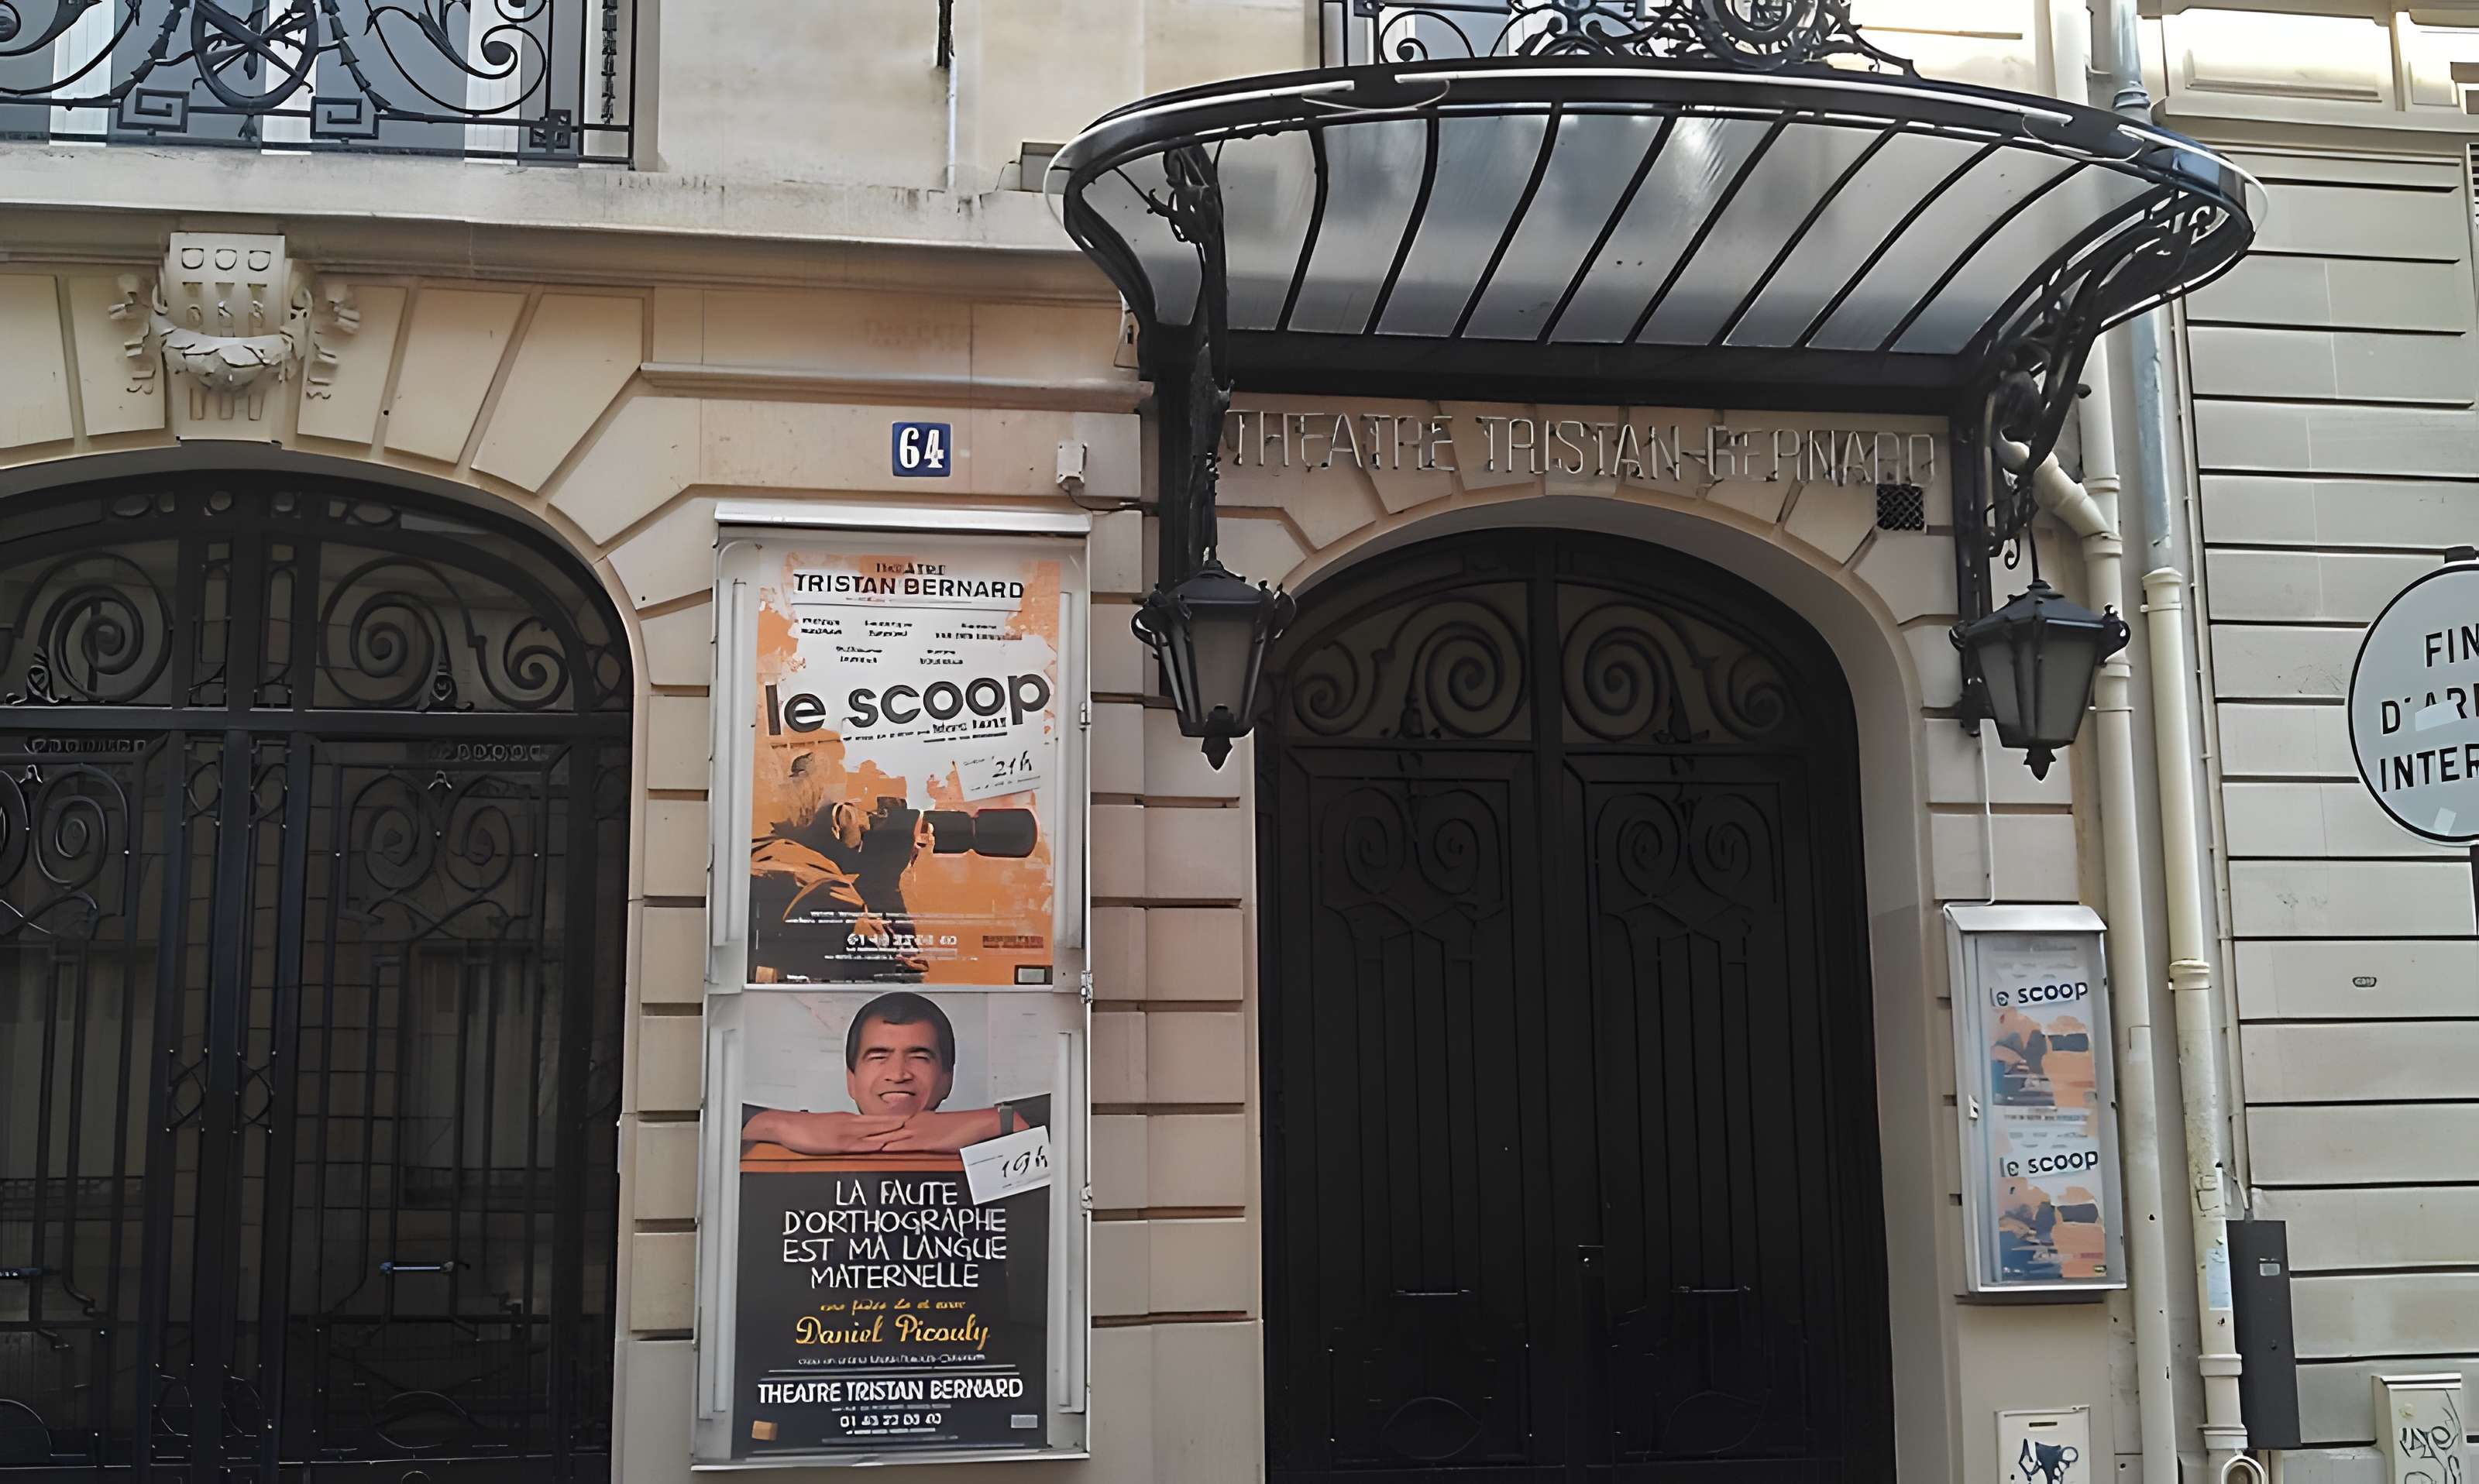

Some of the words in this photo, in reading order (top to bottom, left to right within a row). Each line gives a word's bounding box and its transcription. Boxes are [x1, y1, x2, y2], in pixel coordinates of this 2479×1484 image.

[899, 427, 944, 469] 64
[794, 573, 896, 595] TRISTAN
[903, 578, 1024, 599] BERNARD
[2426, 623, 2479, 668] FIN
[765, 684, 827, 736] le
[848, 673, 1050, 728] scoop
[2379, 743, 2479, 793] INTER
[2017, 981, 2089, 1004] scoop
[2027, 1150, 2099, 1173] scoop
[835, 1179, 867, 1206] LA
[880, 1179, 958, 1206] FAUTE
[782, 1207, 1006, 1237] D'ORTHOGRAPHE
[783, 1238, 834, 1262] EST
[849, 1234, 890, 1261] MA
[903, 1235, 1006, 1262] LANGUE
[811, 1262, 979, 1289] MATERNELLE
[796, 1314, 884, 1345] Daniel
[895, 1313, 989, 1351] Picouly
[758, 1383, 841, 1403] THEATRE
[847, 1380, 923, 1402] TRISTAN
[930, 1378, 1023, 1400] BERNARD
